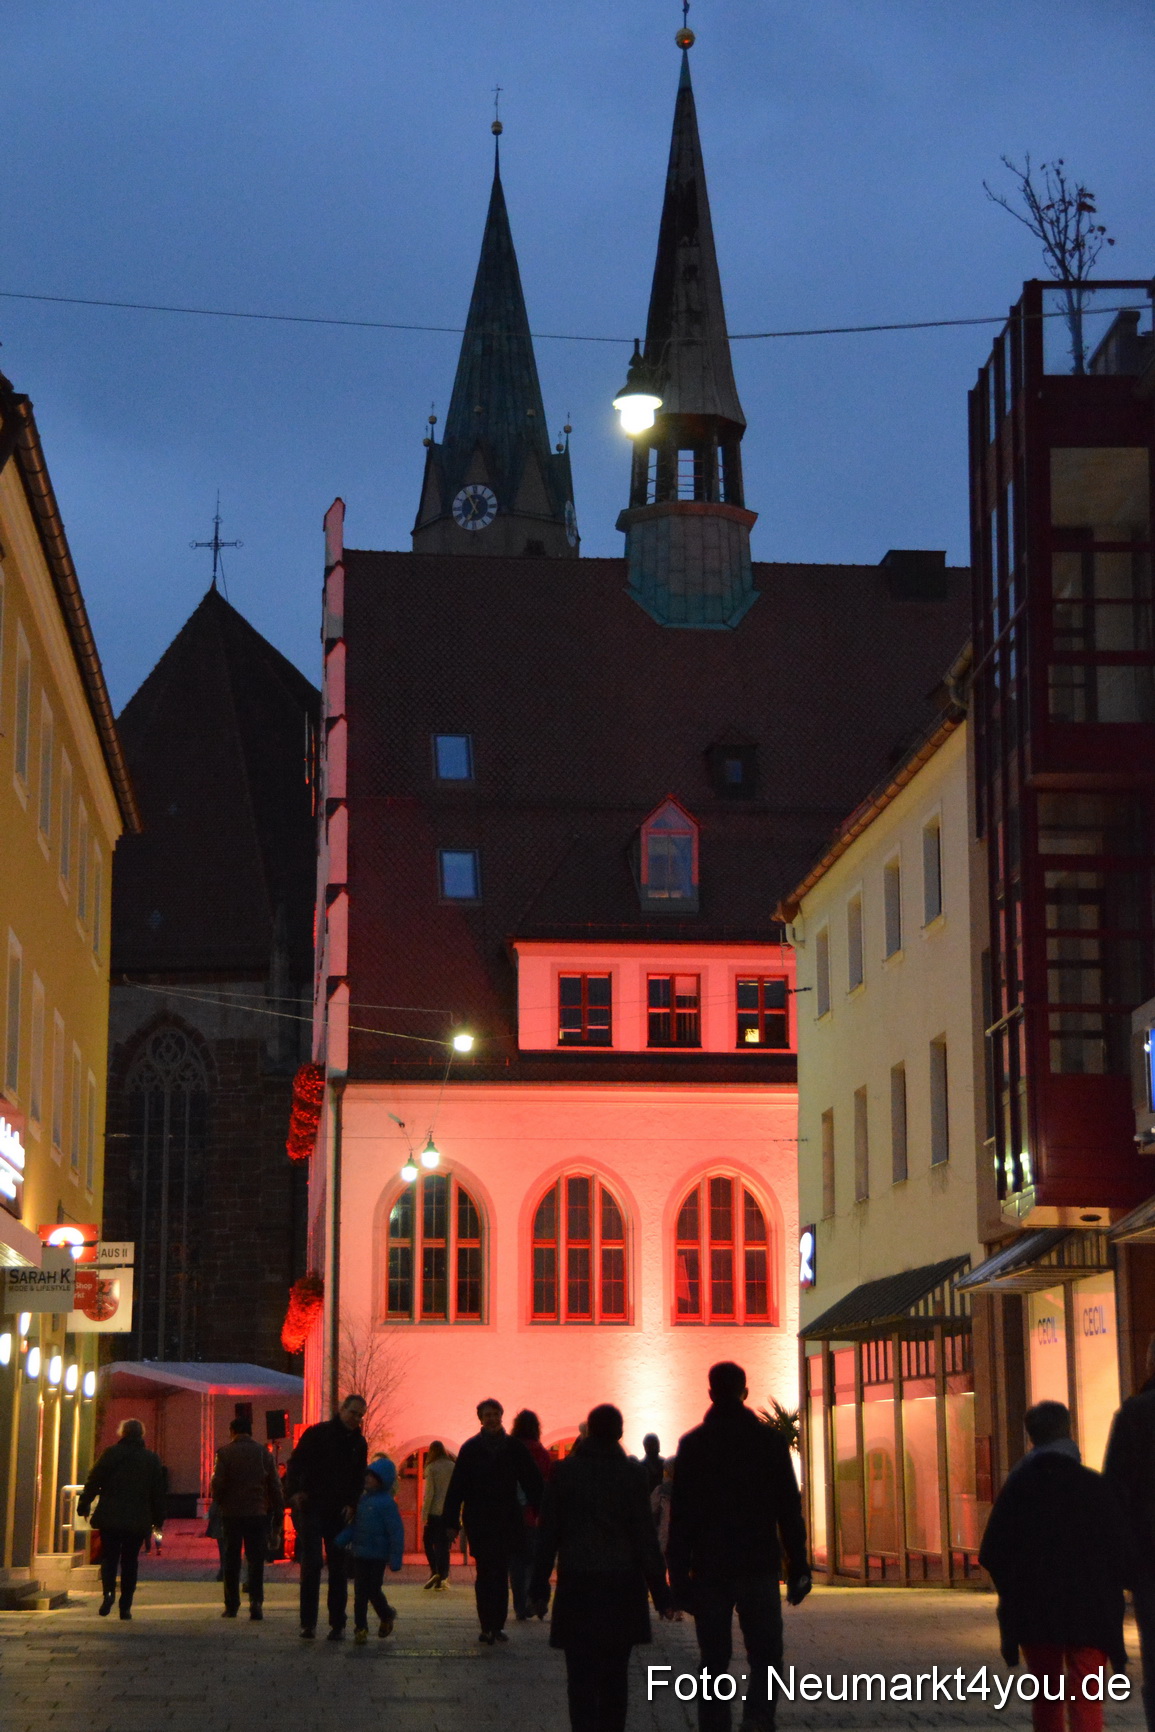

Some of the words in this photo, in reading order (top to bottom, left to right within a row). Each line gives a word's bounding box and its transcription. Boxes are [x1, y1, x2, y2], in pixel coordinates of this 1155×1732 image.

[9, 1268, 57, 1284] SARAH
[60, 1268, 71, 1284] K
[8, 1284, 29, 1292] MODE
[36, 1284, 71, 1292] LIFESTYLE
[1037, 1316, 1058, 1346] CECIL
[1083, 1305, 1107, 1337] CECIL
